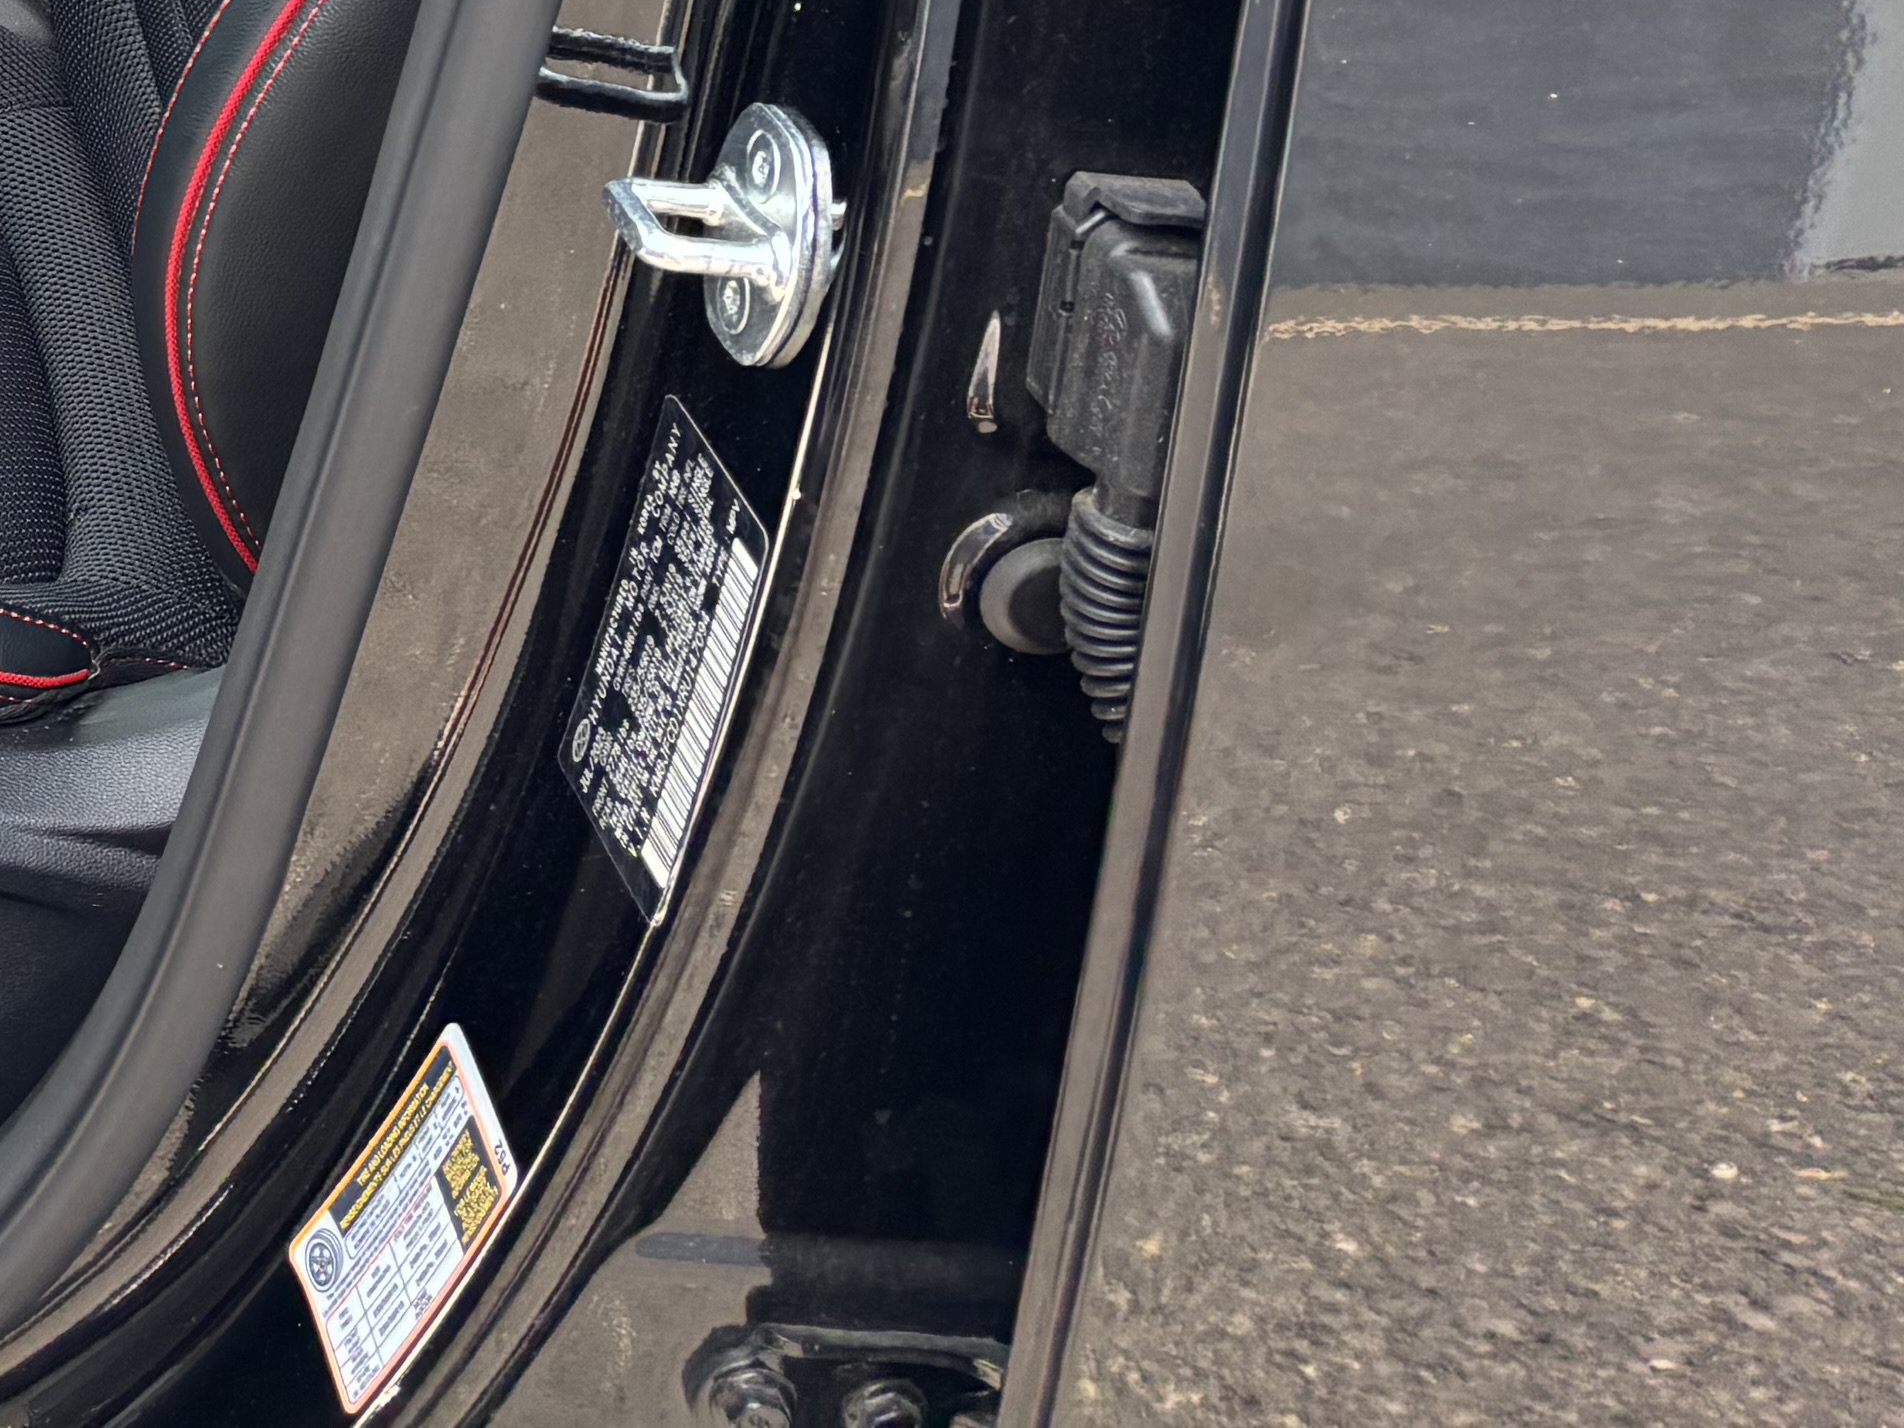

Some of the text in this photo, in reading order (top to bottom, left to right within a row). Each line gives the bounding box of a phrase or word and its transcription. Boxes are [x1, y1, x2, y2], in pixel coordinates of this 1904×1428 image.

[726, 498, 741, 535] MPV
[589, 424, 680, 726] HYUNDAI MOTOR COMPANY
[580, 721, 604, 795] JUL/2023
